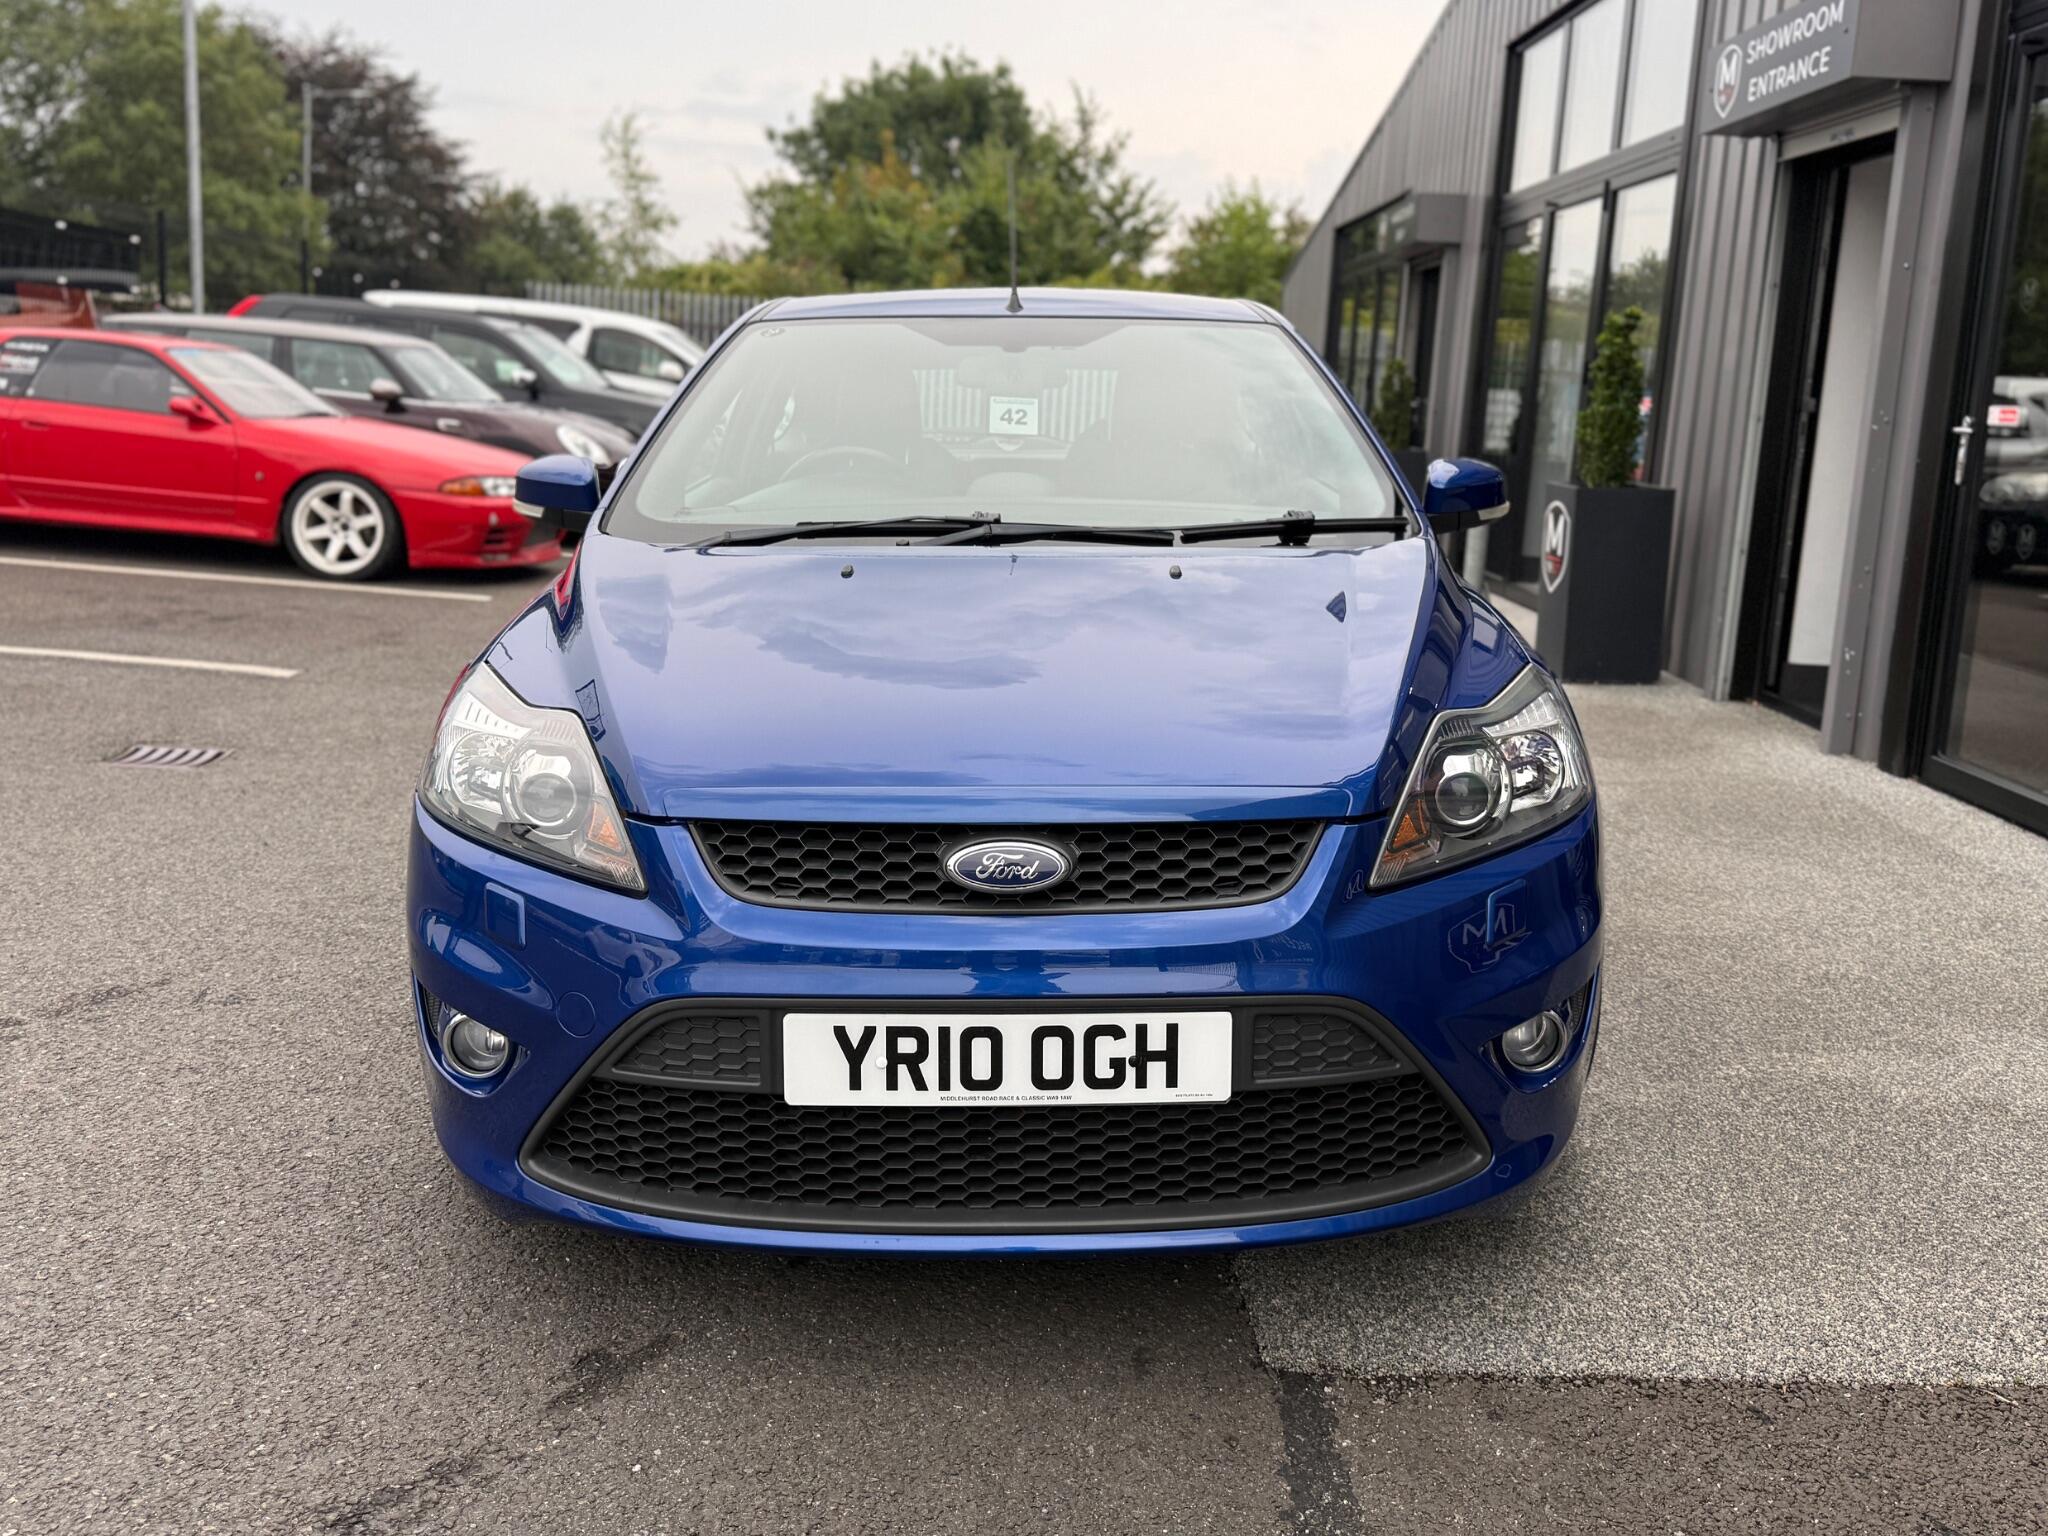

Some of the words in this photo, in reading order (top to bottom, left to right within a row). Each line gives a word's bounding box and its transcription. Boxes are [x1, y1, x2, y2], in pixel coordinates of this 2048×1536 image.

[1746, 0, 1844, 64] SHOWROOM
[1747, 46, 1831, 101] ENTRANCE
[999, 407, 1028, 426] 42
[1546, 511, 1564, 557] M
[975, 852, 1041, 880] Ford
[833, 1025, 1003, 1091] YR10
[1031, 1023, 1179, 1090] OGH
